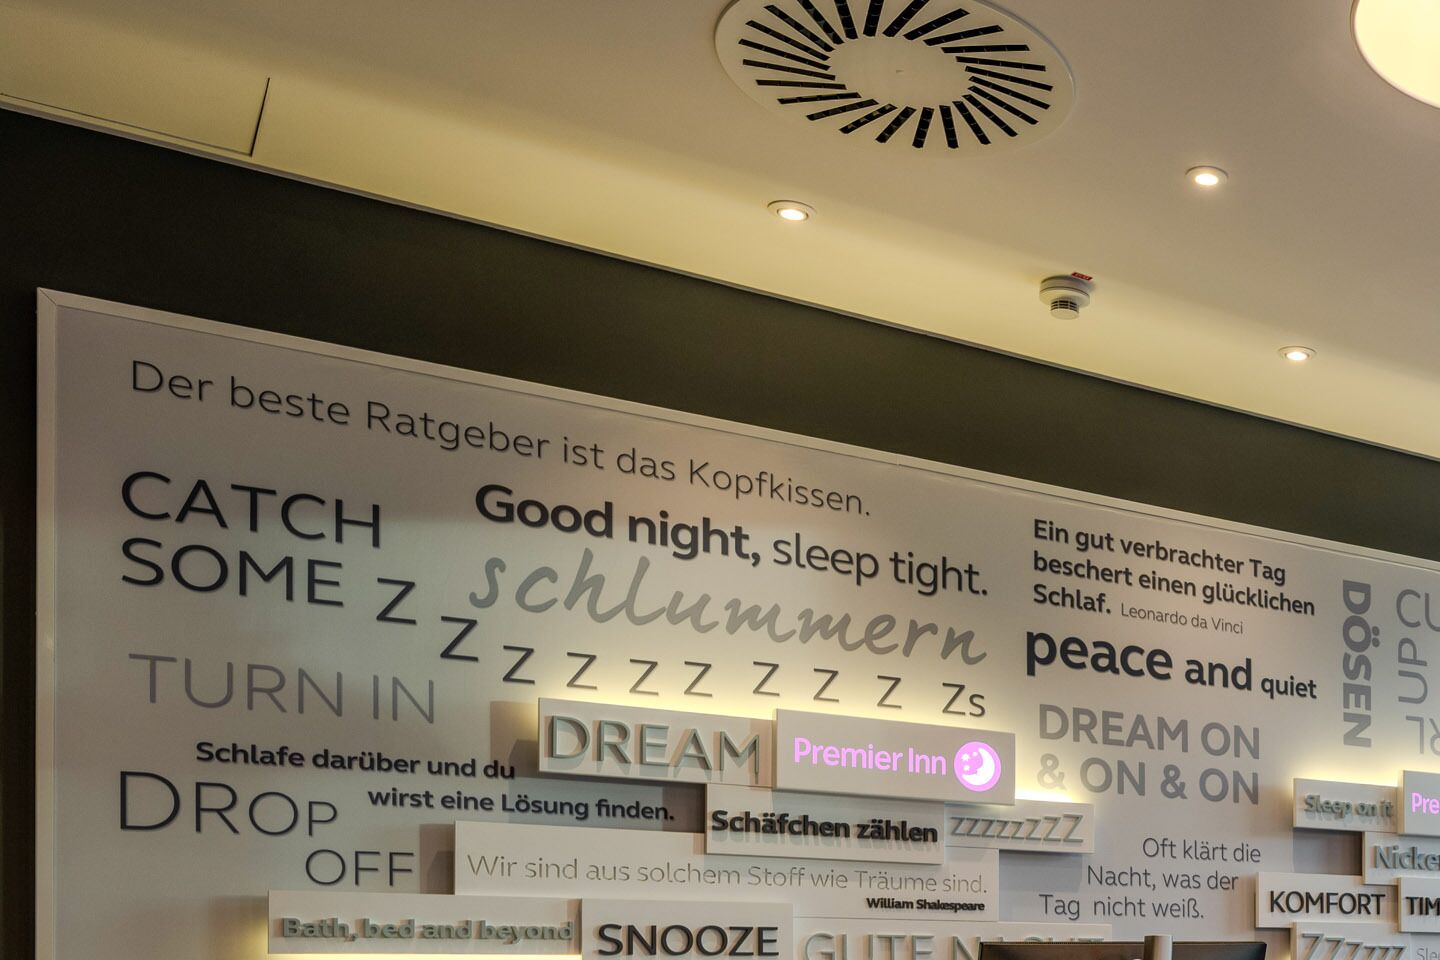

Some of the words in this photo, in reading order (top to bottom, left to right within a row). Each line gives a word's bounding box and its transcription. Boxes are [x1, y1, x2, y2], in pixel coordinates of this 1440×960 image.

[131, 360, 214, 402] Der
[230, 376, 351, 426] beste
[367, 401, 550, 459] Ratgeber
[563, 436, 604, 470] ist
[617, 448, 676, 481] das
[689, 460, 870, 516] Kopfkissen.
[121, 471, 380, 548] CATCH
[475, 484, 614, 539] Good
[628, 510, 761, 567] night,
[772, 533, 880, 580] sleep
[890, 551, 988, 597] tight.
[1034, 519, 1069, 544] Ein
[1076, 529, 1114, 552] gut
[1120, 539, 1244, 574] verbrachter
[1249, 559, 1286, 586] Tag
[468, 547, 987, 665] schlummern
[1033, 584, 1111, 614] Schlaf.
[1121, 602, 1187, 626] Leonardo
[1191, 614, 1208, 629] da
[1211, 616, 1243, 634] Vinci
[1034, 551, 1133, 586] beschert
[1139, 572, 1196, 597] einen
[1202, 583, 1315, 616] glücklichen
[121, 537, 344, 607] SOME
[941, 682, 986, 718] Zs
[128, 653, 343, 717] TURN
[373, 674, 434, 723] IN
[1026, 630, 1173, 680] peace
[1185, 657, 1252, 690] and
[1261, 675, 1317, 699] quiet
[1342, 580, 1380, 748] DÖSEN
[1397, 637, 1428, 704] UP
[549, 715, 760, 782] DREAM
[794, 736, 903, 772] Premier
[908, 748, 947, 776] Inn
[1039, 703, 1188, 753] DREAM
[1200, 722, 1260, 760] ON
[195, 741, 305, 768] Schlafe
[312, 749, 420, 776] darüber
[427, 758, 477, 778] und
[484, 759, 516, 780] du
[1037, 753, 1067, 790] &
[1079, 757, 1146, 796] ON
[1160, 764, 1188, 799] &
[1199, 768, 1259, 805] ON
[118, 771, 338, 837] DROP
[367, 788, 434, 808] wirst
[441, 790, 494, 811] eine
[501, 794, 589, 820] Lösung
[596, 799, 674, 820] finden.
[711, 810, 850, 840] Schäfchen
[857, 819, 938, 843] zählen
[1304, 794, 1352, 818] Sleep
[1355, 801, 1376, 816] on
[1380, 799, 1393, 817] it
[305, 849, 414, 886] OFF
[467, 854, 518, 877] Wir
[525, 858, 578, 880] sind
[586, 863, 630, 881] aus
[637, 862, 740, 885] solchem
[747, 866, 805, 887] Stoff
[811, 870, 848, 889] wie
[854, 870, 937, 893] Träume
[942, 874, 987, 894] sind.
[1142, 838, 1177, 859] Oft
[1183, 839, 1227, 862] klärt
[1233, 842, 1261, 863] die
[1087, 865, 1156, 891] Nacht,
[1163, 872, 1201, 889] was
[1207, 870, 1239, 890] der
[1270, 890, 1385, 916] KOMFORT
[866, 898, 914, 911] William
[916, 899, 985, 913] Shakespeare
[1039, 894, 1080, 920] Tag
[1093, 896, 1146, 917] nicht
[1152, 897, 1203, 919] weiß.
[282, 917, 357, 942] Bath,
[365, 917, 415, 941] bed
[423, 920, 472, 941] and
[478, 919, 574, 946] beyond
[598, 923, 779, 957] SNOOZE
